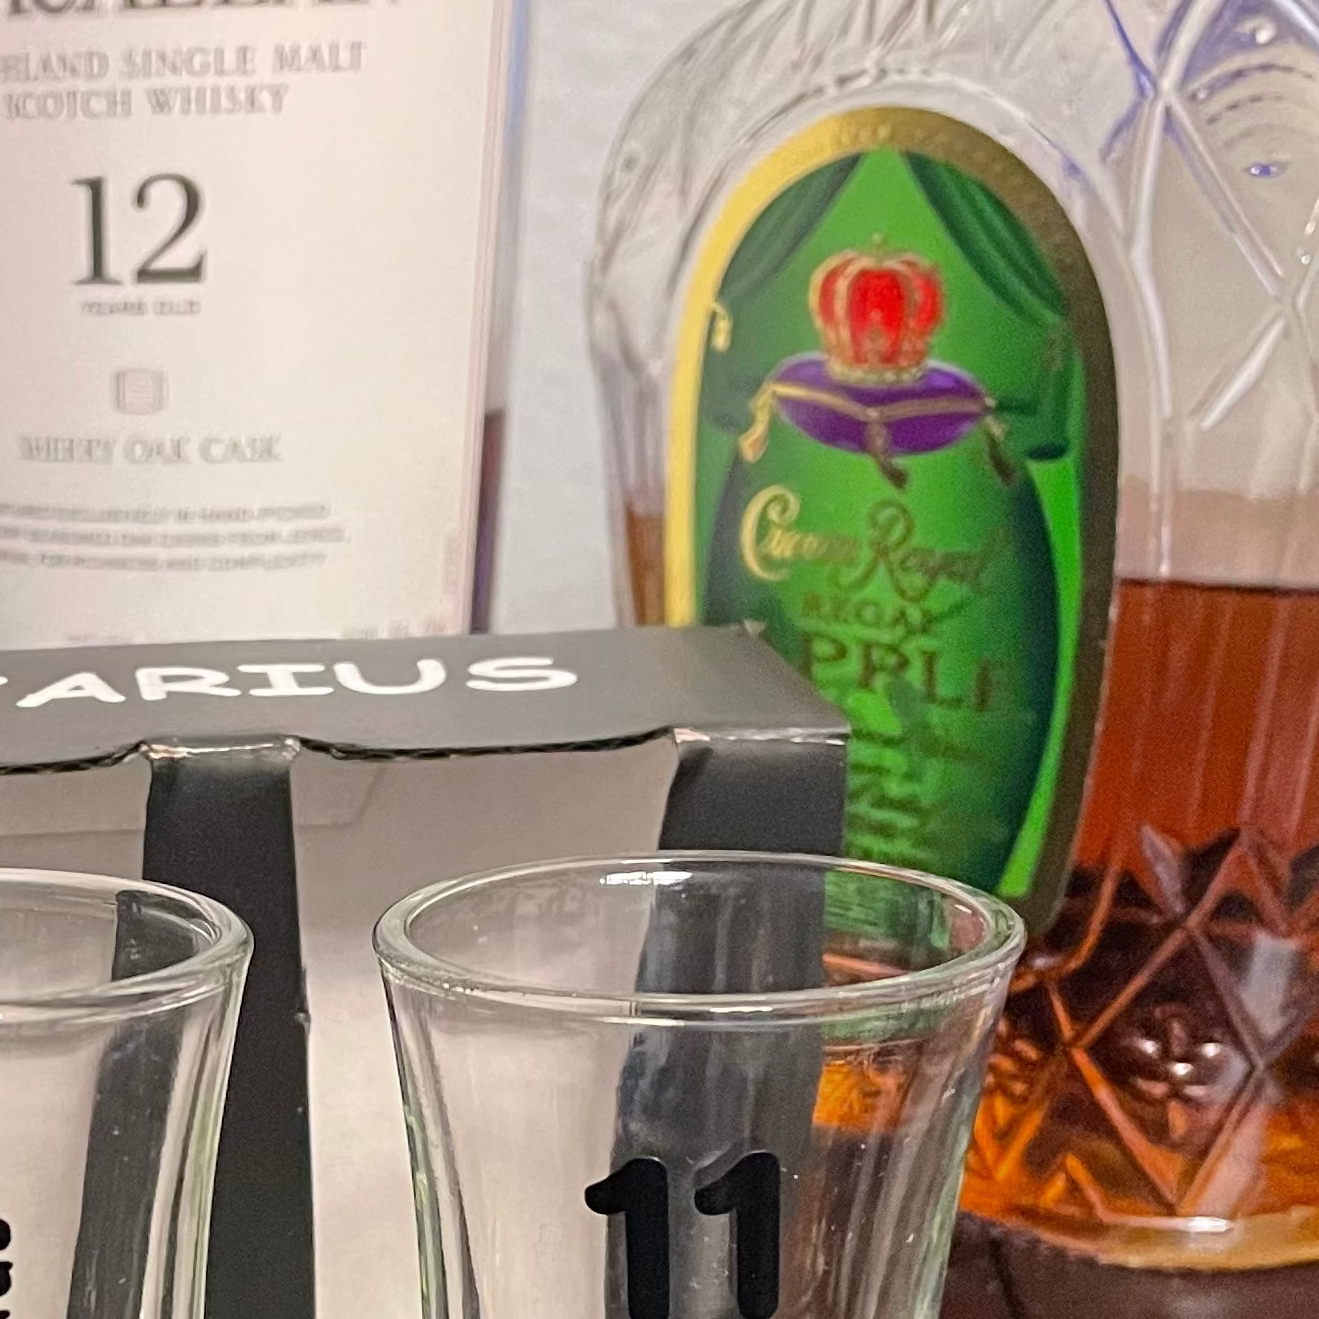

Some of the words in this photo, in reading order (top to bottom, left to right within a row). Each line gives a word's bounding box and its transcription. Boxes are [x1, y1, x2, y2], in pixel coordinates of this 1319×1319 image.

[118, 45, 257, 79] SINGLE
[272, 40, 368, 74] MALT
[4, 87, 133, 121] SCOTCH
[145, 82, 291, 117] WHISKY
[72, 172, 208, 287] 12
[122, 436, 192, 464] OAK
[799, 630, 1016, 713] PPLE
